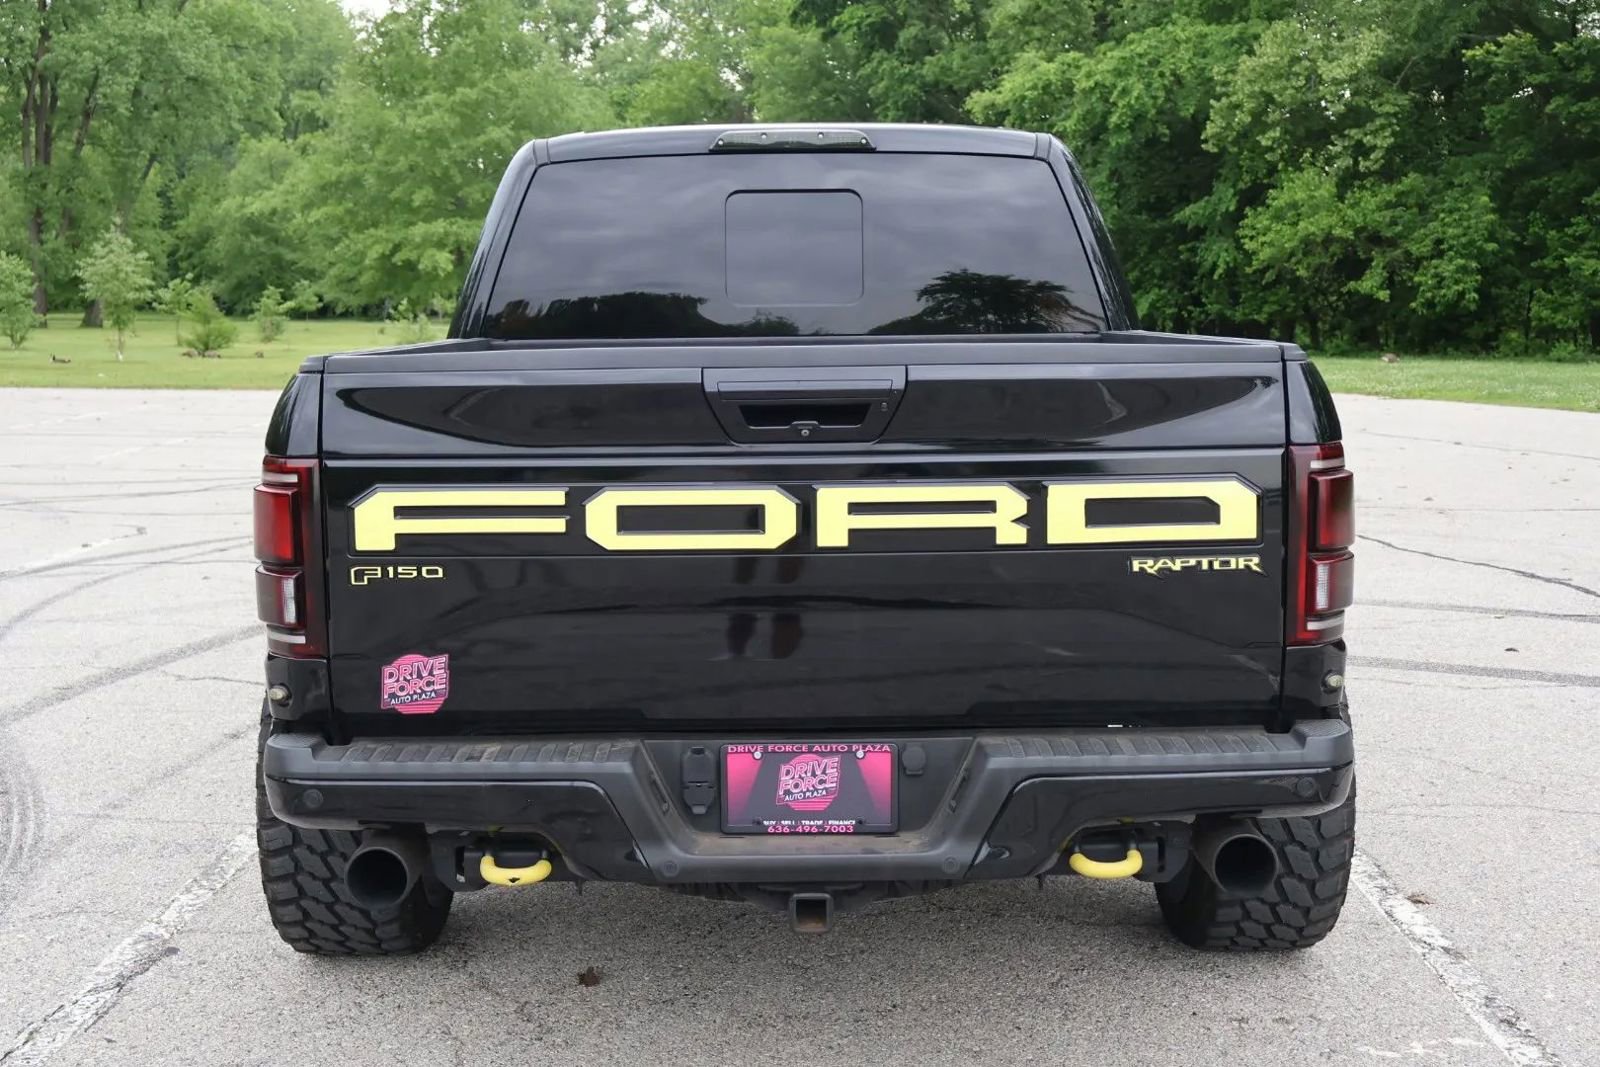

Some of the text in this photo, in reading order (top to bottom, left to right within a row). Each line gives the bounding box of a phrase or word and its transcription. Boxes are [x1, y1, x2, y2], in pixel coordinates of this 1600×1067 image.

[354, 480, 1258, 551] FORD
[1131, 556, 1268, 580] RAPTOR
[383, 656, 446, 684] DRIVE
[383, 673, 447, 699] FORCE
[390, 691, 436, 705] AUTO PLAZA
[728, 744, 891, 752] DRIVE FORCE AUTO PLAZA
[781, 757, 838, 780] DRIVE
[779, 773, 838, 795] FORCE
[784, 789, 827, 802] AUTO PLAZA
[767, 825, 854, 833] 636-496-7003
